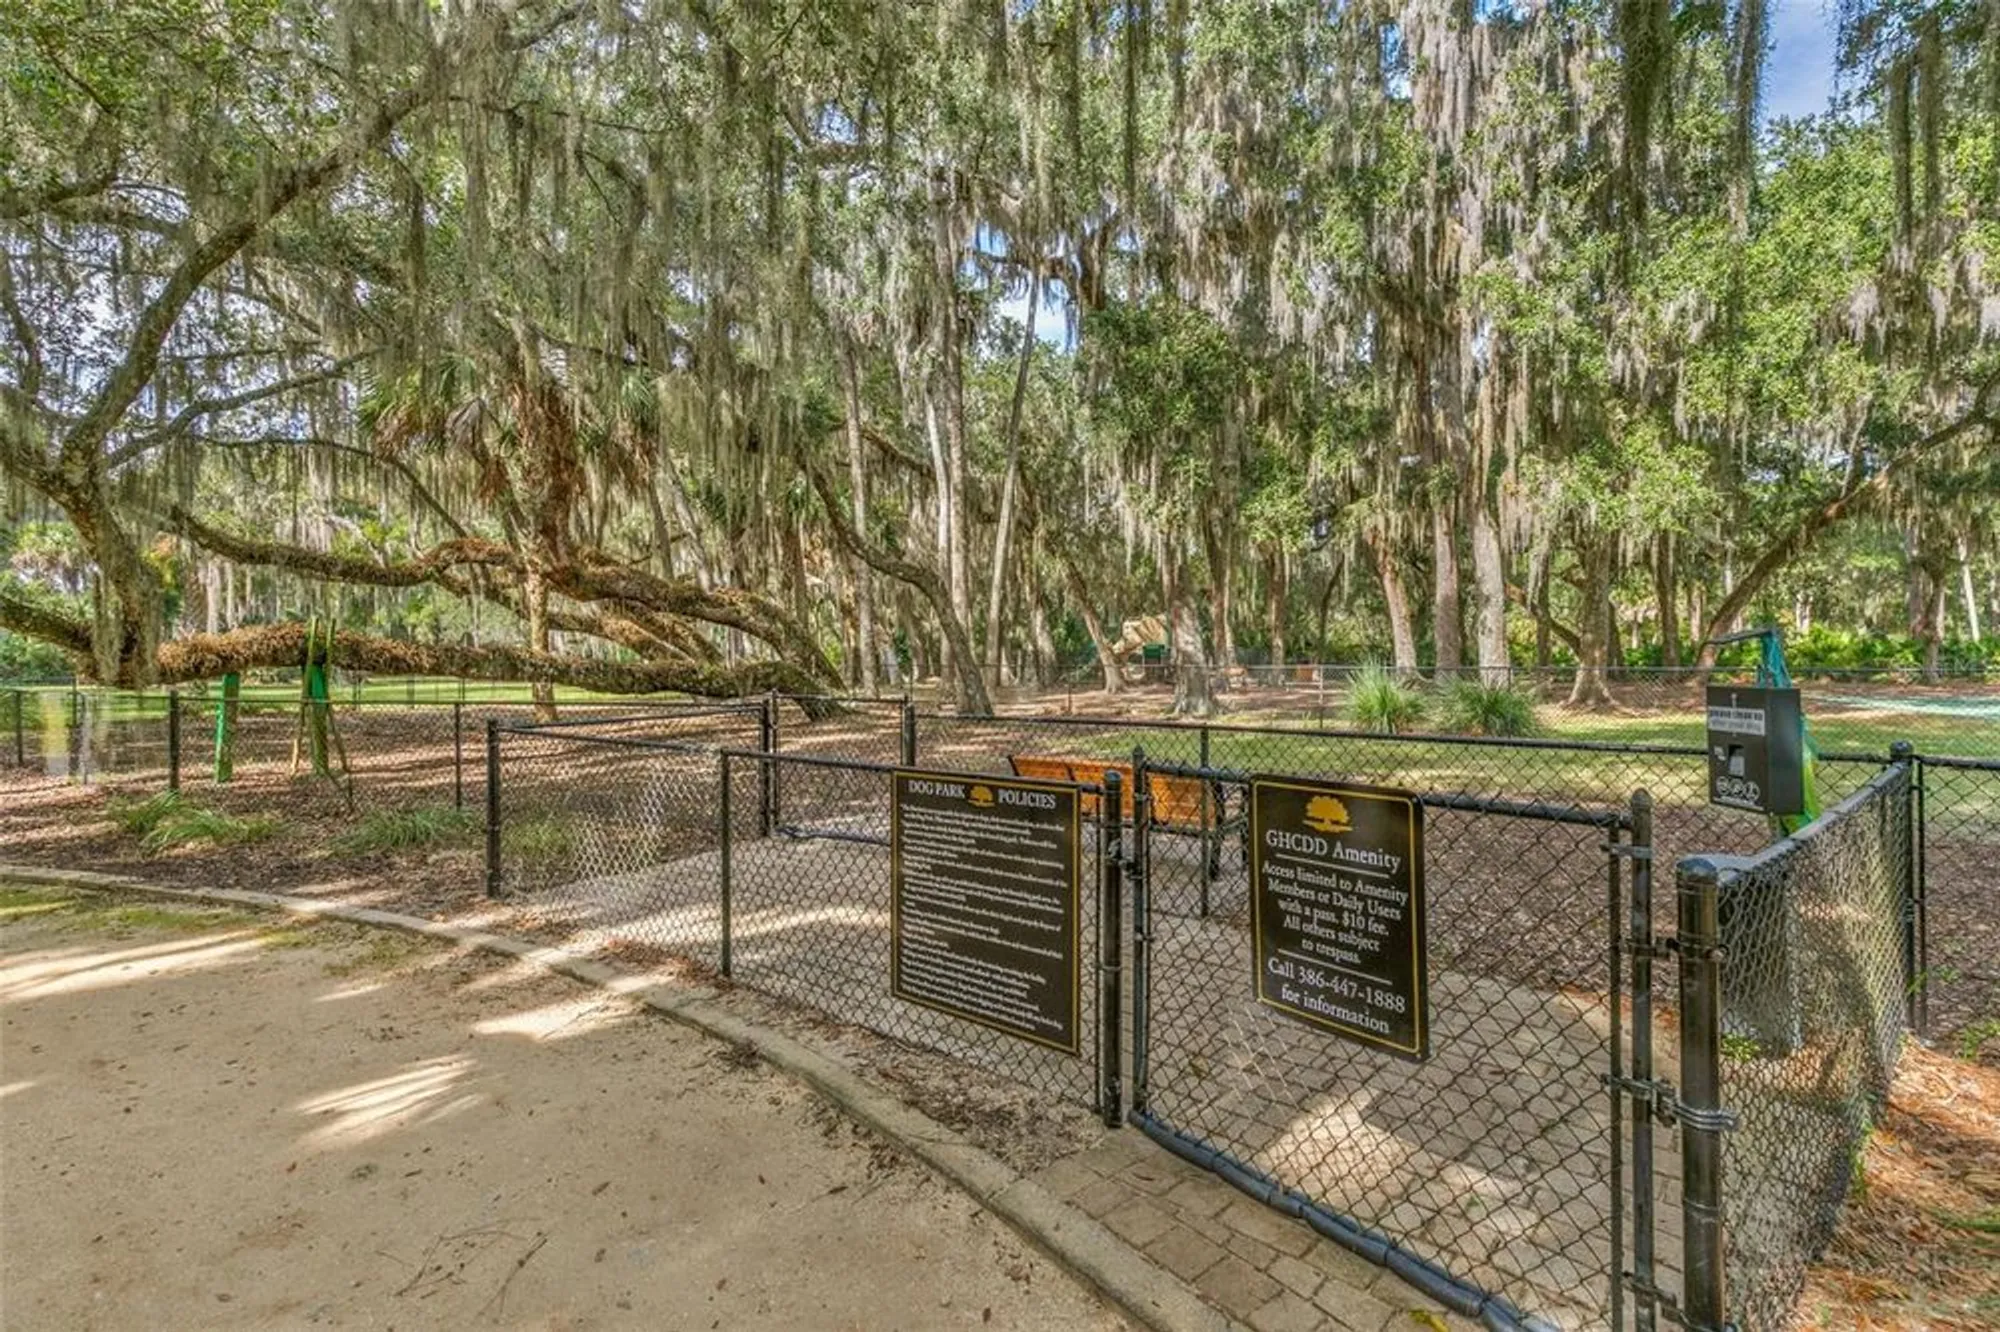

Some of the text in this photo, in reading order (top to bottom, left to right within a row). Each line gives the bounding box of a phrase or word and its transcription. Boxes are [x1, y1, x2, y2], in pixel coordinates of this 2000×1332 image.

[908, 780, 1056, 809] DOG PARK POLICIES
[1266, 829, 1401, 874] GHCDD Amenity
[1263, 861, 1408, 906] Access limited to Amenity
[1267, 879, 1401, 920] Members or Daily Users
[1278, 899, 1389, 936] with a pass. $10 fee.
[1283, 915, 1380, 951] All others subject
[1302, 939, 1313, 951] to
[1268, 957, 1406, 1013] Call 386-447-1888
[1281, 984, 1390, 1033] for information
